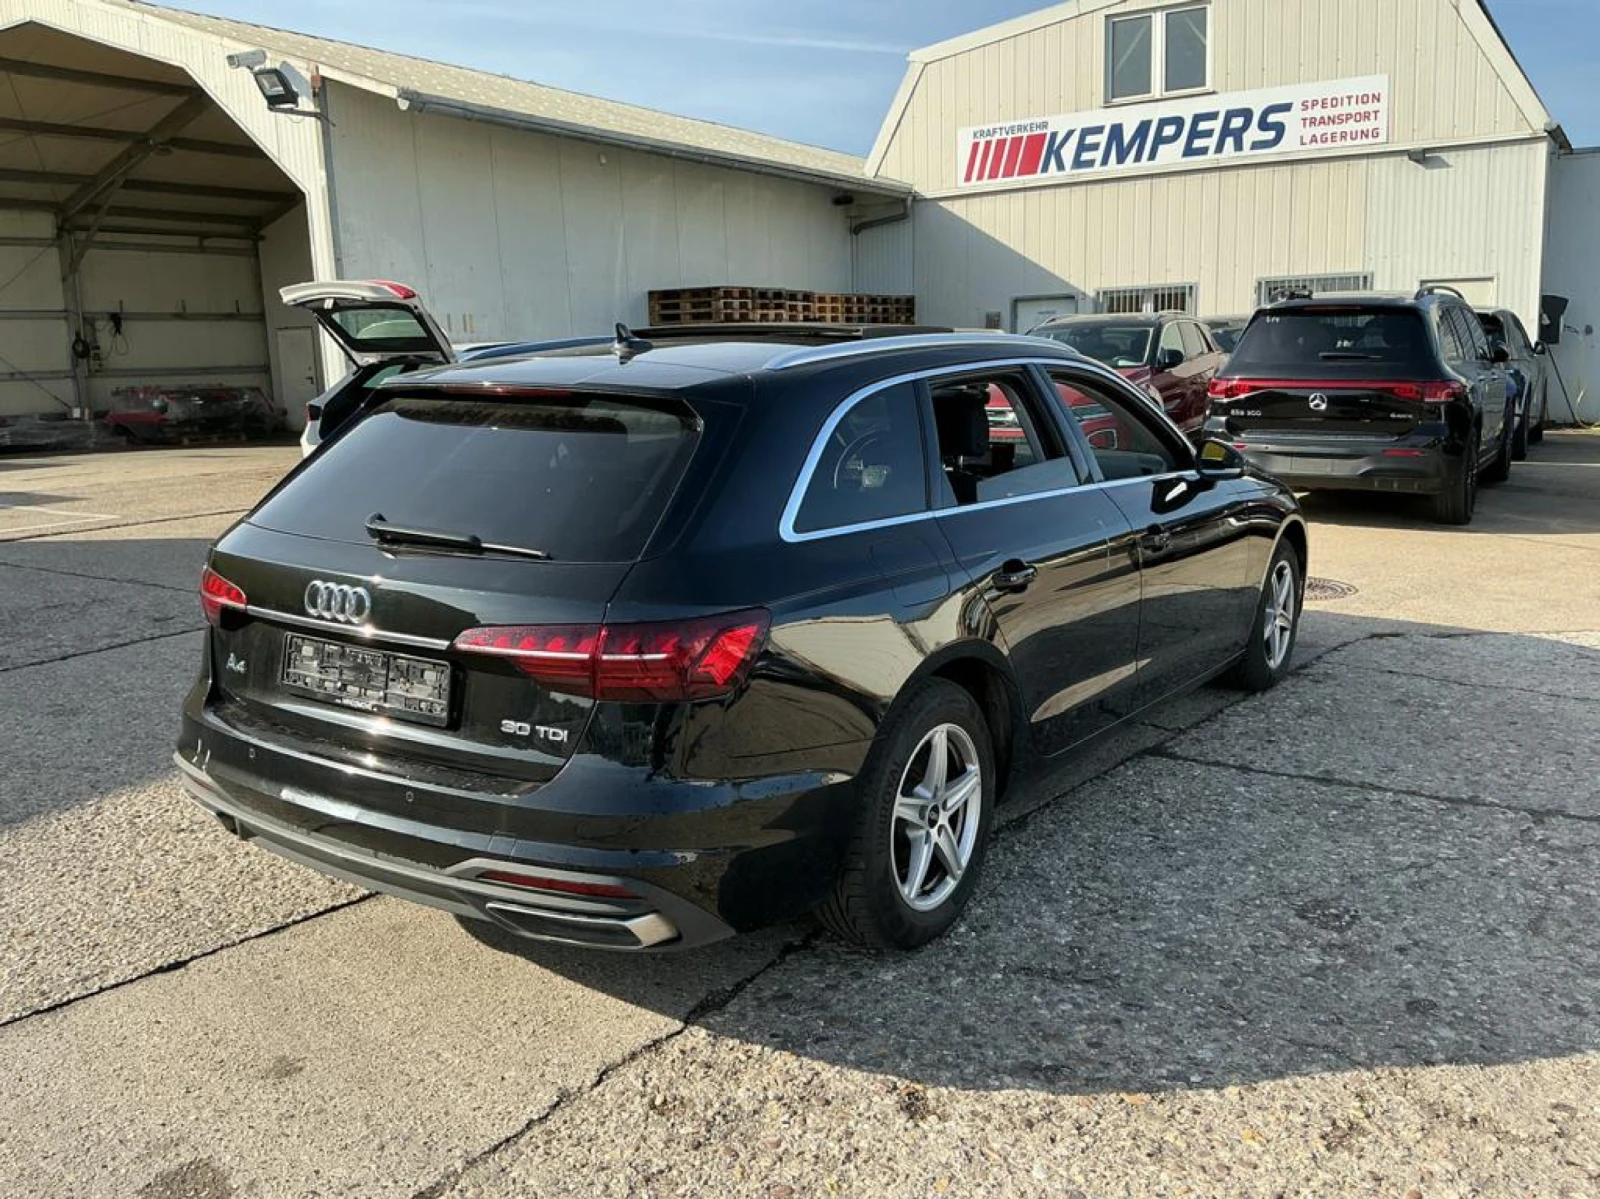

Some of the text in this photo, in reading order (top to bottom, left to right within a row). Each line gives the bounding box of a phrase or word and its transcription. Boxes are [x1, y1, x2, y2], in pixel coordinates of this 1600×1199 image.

[1300, 92, 1381, 111] SPEDITION
[1300, 110, 1380, 128] TRANSPORT
[973, 121, 1049, 140] KRAFTVERKEHR
[1040, 102, 1293, 174] KEMPERS
[1299, 127, 1380, 146] LAGERUNG
[225, 652, 247, 675] A4
[500, 719, 568, 743] 30 TDI
